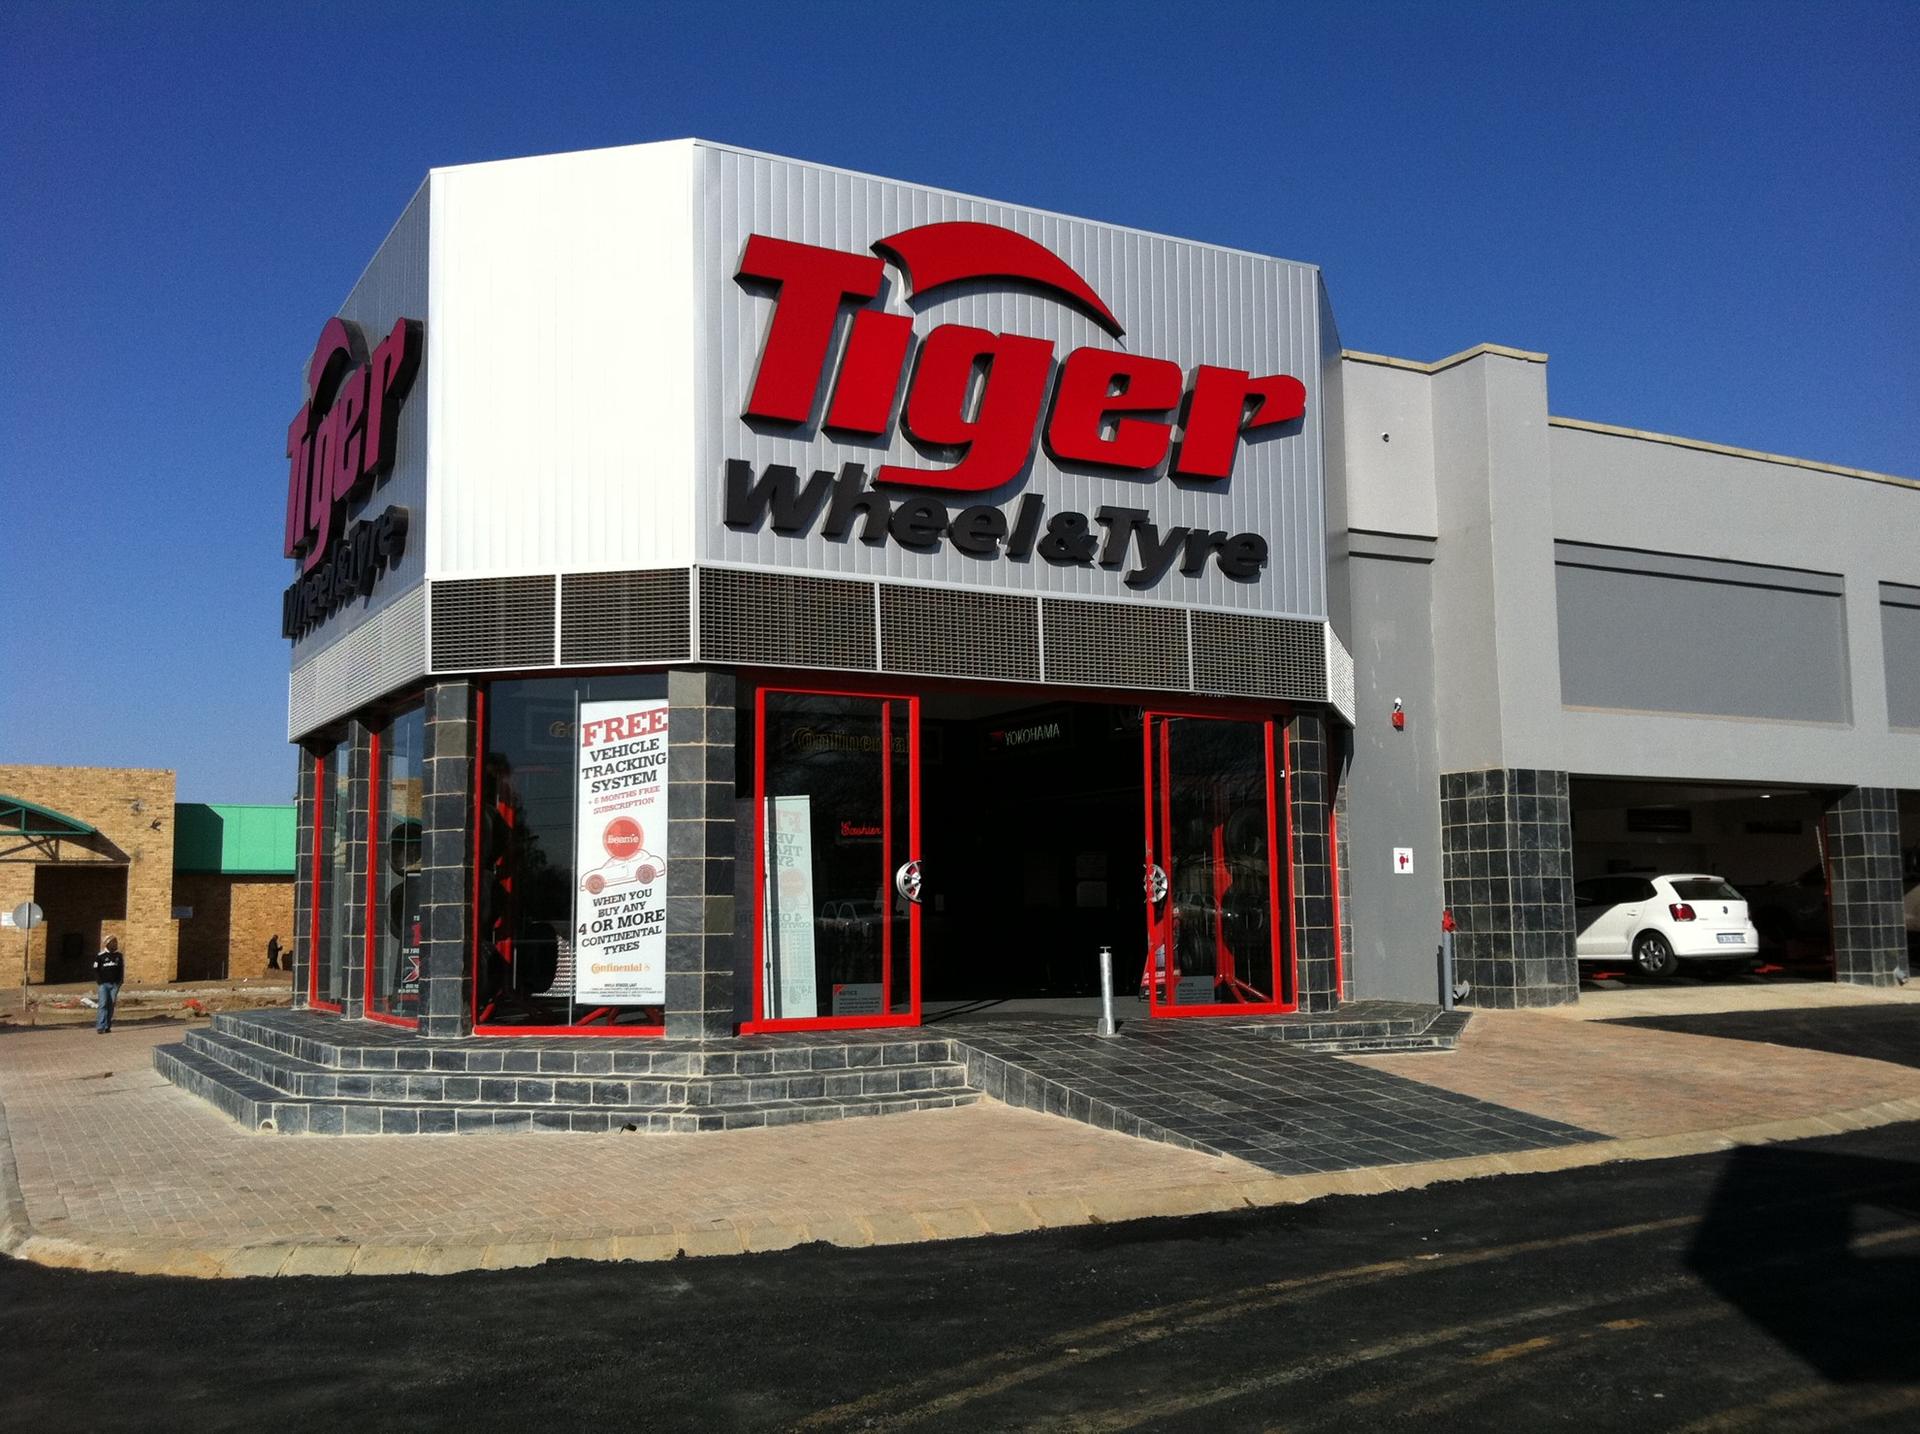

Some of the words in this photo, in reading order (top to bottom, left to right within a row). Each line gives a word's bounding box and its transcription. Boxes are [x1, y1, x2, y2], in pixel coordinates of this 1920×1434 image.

[732, 223, 1307, 491] Tiger
[284, 317, 422, 574] Tiger
[582, 707, 668, 747] FREE
[1005, 723, 1060, 746] YOKOHAMA
[590, 738, 660, 762] VEHICLE
[582, 752, 667, 780] TRACKING
[591, 770, 657, 793] SYSTEM
[600, 789, 638, 803] MONTHS
[639, 785, 661, 796] FREE
[593, 797, 655, 815] SUBSCRIPTION
[593, 893, 626, 907] WHEN
[630, 888, 652, 900] YOU
[598, 906, 620, 918] BUY
[622, 901, 647, 914] ANY
[578, 923, 587, 936] 4
[591, 919, 613, 934] OR
[617, 909, 666, 930] MORE
[581, 926, 662, 947] CONTINENTAL
[603, 941, 640, 955] TYRES
[591, 963, 642, 974] Continental
